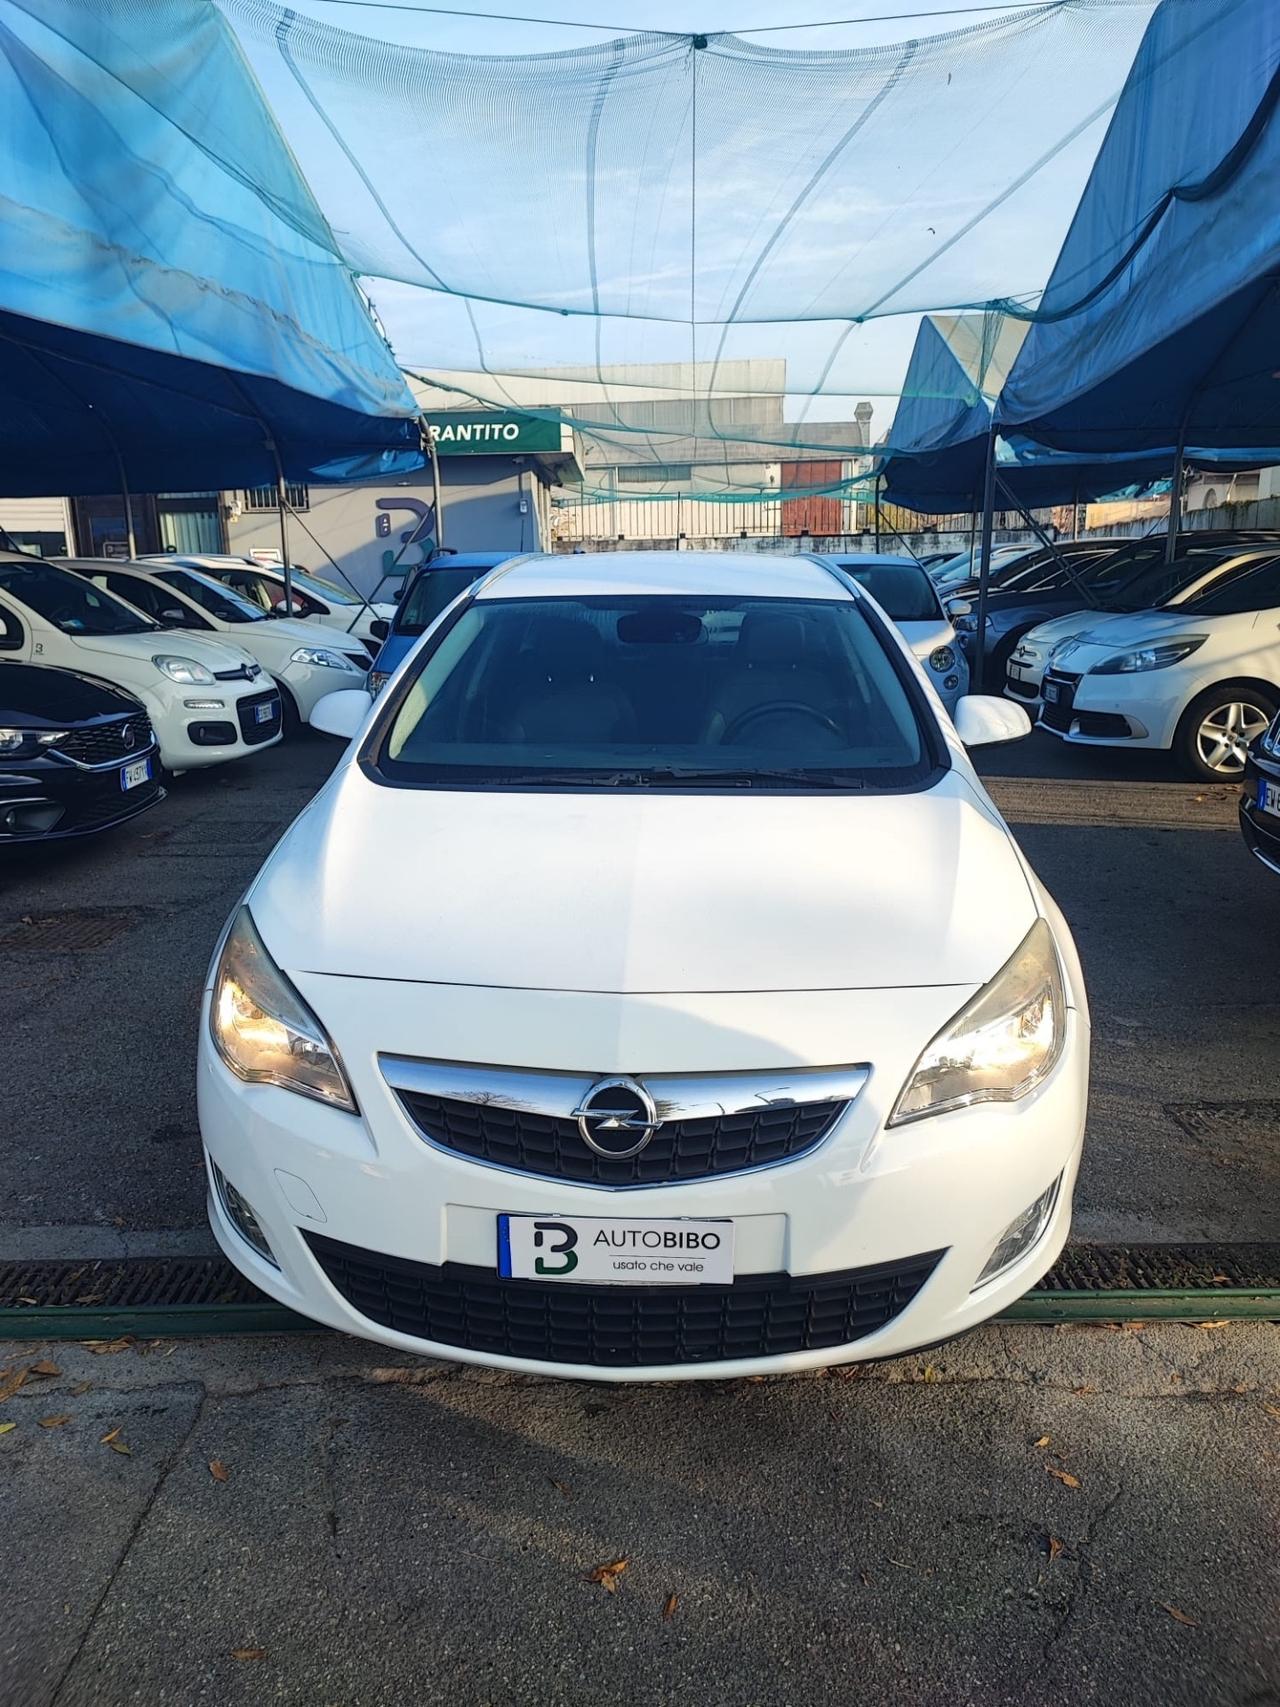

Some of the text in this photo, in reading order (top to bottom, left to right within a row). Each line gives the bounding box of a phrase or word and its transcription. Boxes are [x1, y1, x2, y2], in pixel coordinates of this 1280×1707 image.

[593, 1229, 721, 1250] AUTOBIBO
[613, 1260, 704, 1272] usato che vale
